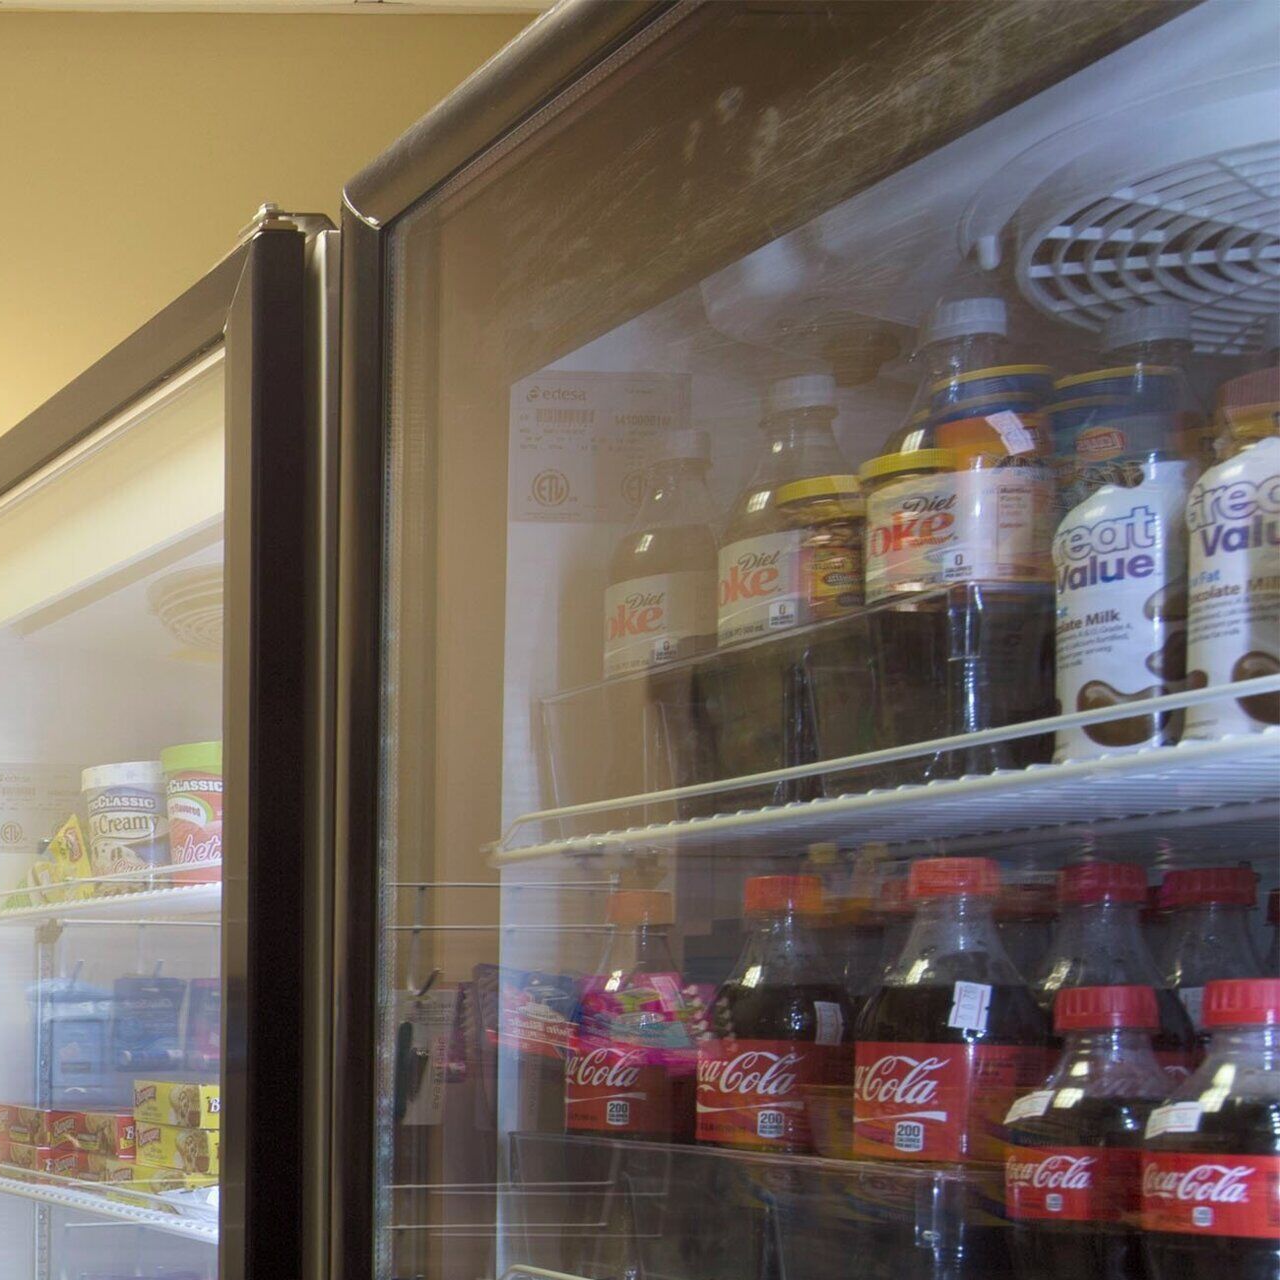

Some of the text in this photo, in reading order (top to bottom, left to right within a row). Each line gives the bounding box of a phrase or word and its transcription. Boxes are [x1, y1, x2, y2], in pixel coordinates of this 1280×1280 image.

[903, 494, 958, 513] Diet
[739, 551, 780, 570] Diet
[954, 553, 963, 566] 0
[1200, 569, 1220, 582] Fat
[625, 592, 665, 609] Diet
[1085, 608, 1121, 626] Milk
[169, 779, 223, 793] CLASSIC
[96, 795, 156, 809] CLASSIC
[99, 815, 160, 834] Creamy
[608, 1103, 628, 1113] 200
[760, 1113, 783, 1124] 200
[897, 1125, 921, 1137] 200
[1143, 1162, 1256, 1203] Coca-Cola
